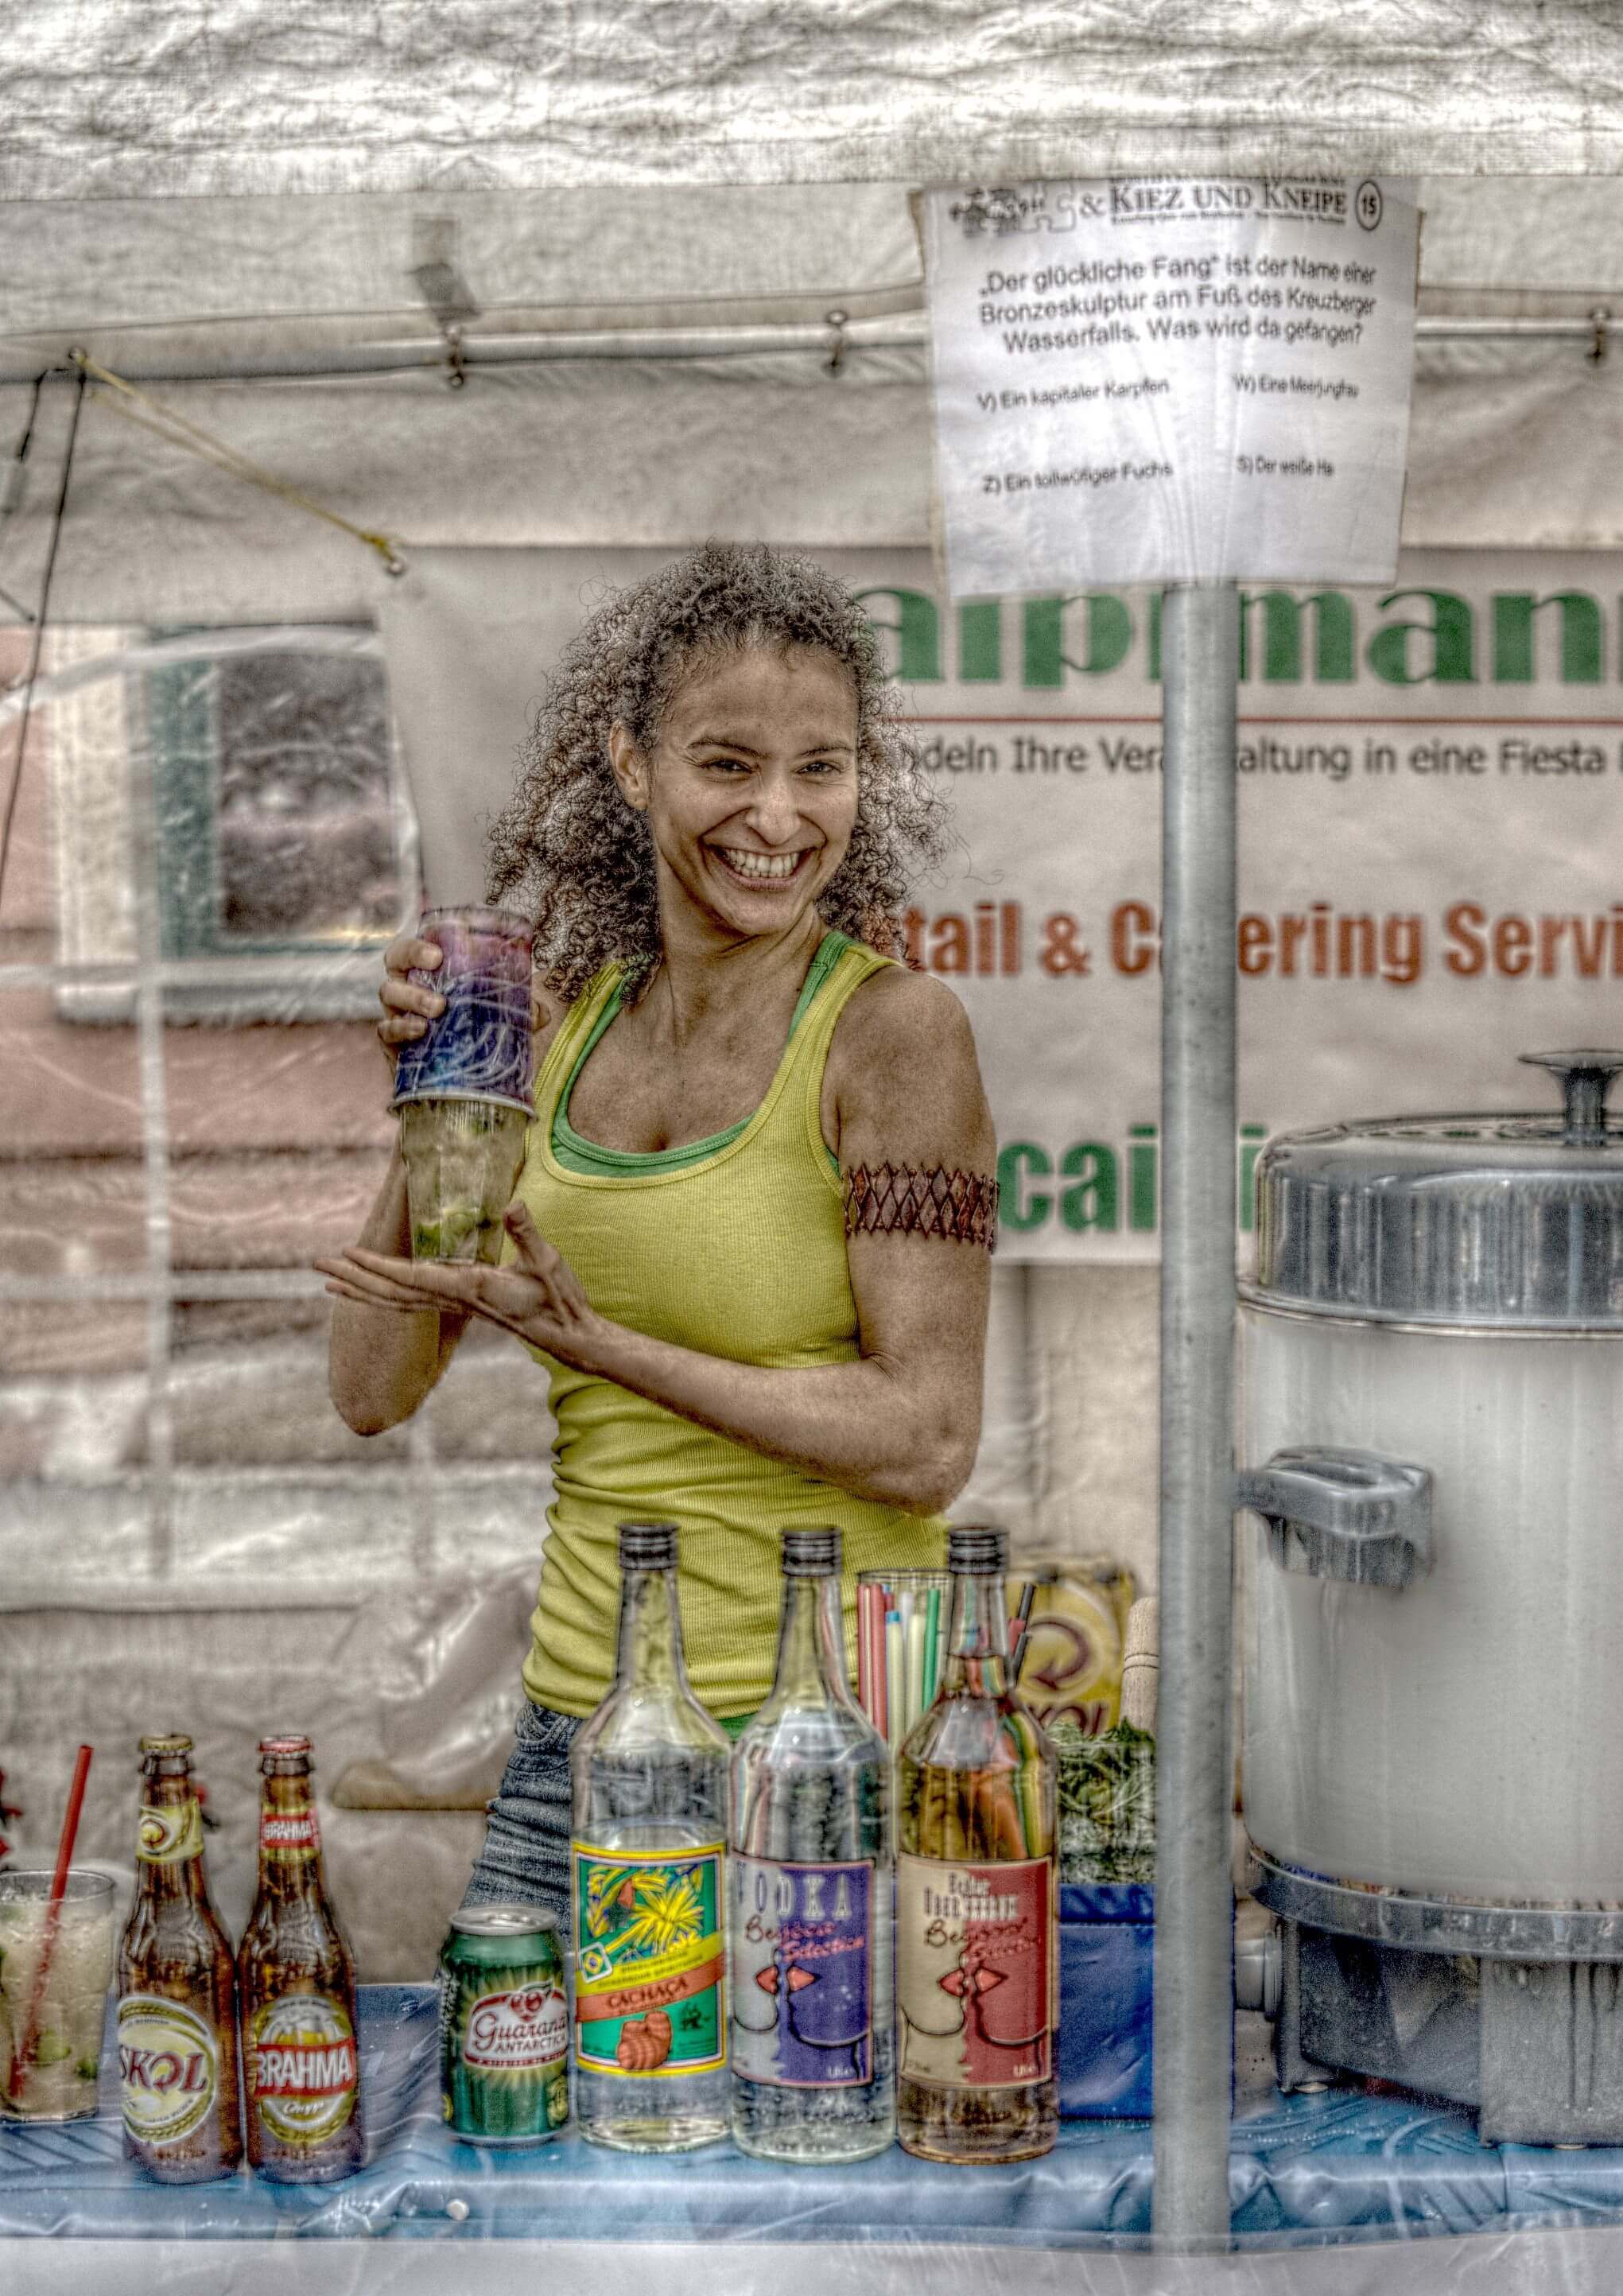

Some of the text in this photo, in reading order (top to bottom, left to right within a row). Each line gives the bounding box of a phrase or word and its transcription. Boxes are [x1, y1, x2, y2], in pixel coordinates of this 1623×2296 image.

[1112, 185, 1185, 212] KIEZ
[1194, 185, 1253, 209] UND
[1263, 182, 1347, 214] KNEIPE
[1362, 196, 1376, 216] 15
[1034, 259, 1146, 294] glückliche
[1225, 254, 1252, 278] ist
[1255, 254, 1287, 278] der
[1292, 255, 1340, 281] Name
[1344, 260, 1376, 285] einer
[980, 284, 1376, 325] Bronzeskulptur am Fuß des Kreuzberger
[1146, 317, 1200, 341] Was
[1206, 316, 1251, 339] wird
[1256, 316, 1281, 339] da
[1285, 319, 1363, 348] gefangen?
[1000, 390, 1027, 410] Ein
[1030, 384, 1100, 407] kapitaler
[1104, 376, 1170, 398] Karpfen
[1259, 374, 1288, 394] Eine
[1005, 472, 1031, 491] Ein
[1120, 460, 1174, 481] Fuchs
[1256, 454, 1277, 474] Der
[921, 735, 998, 773] deln
[1011, 736, 1087, 773] Ihre
[1365, 736, 1397, 775] in
[1408, 736, 1486, 775] eine
[1500, 737, 1607, 775] Fiesta
[903, 900, 1022, 977] tail
[1041, 913, 1092, 977] &
[1443, 900, 1623, 978] Servi
[256, 2045, 352, 2088] BRAHMA
